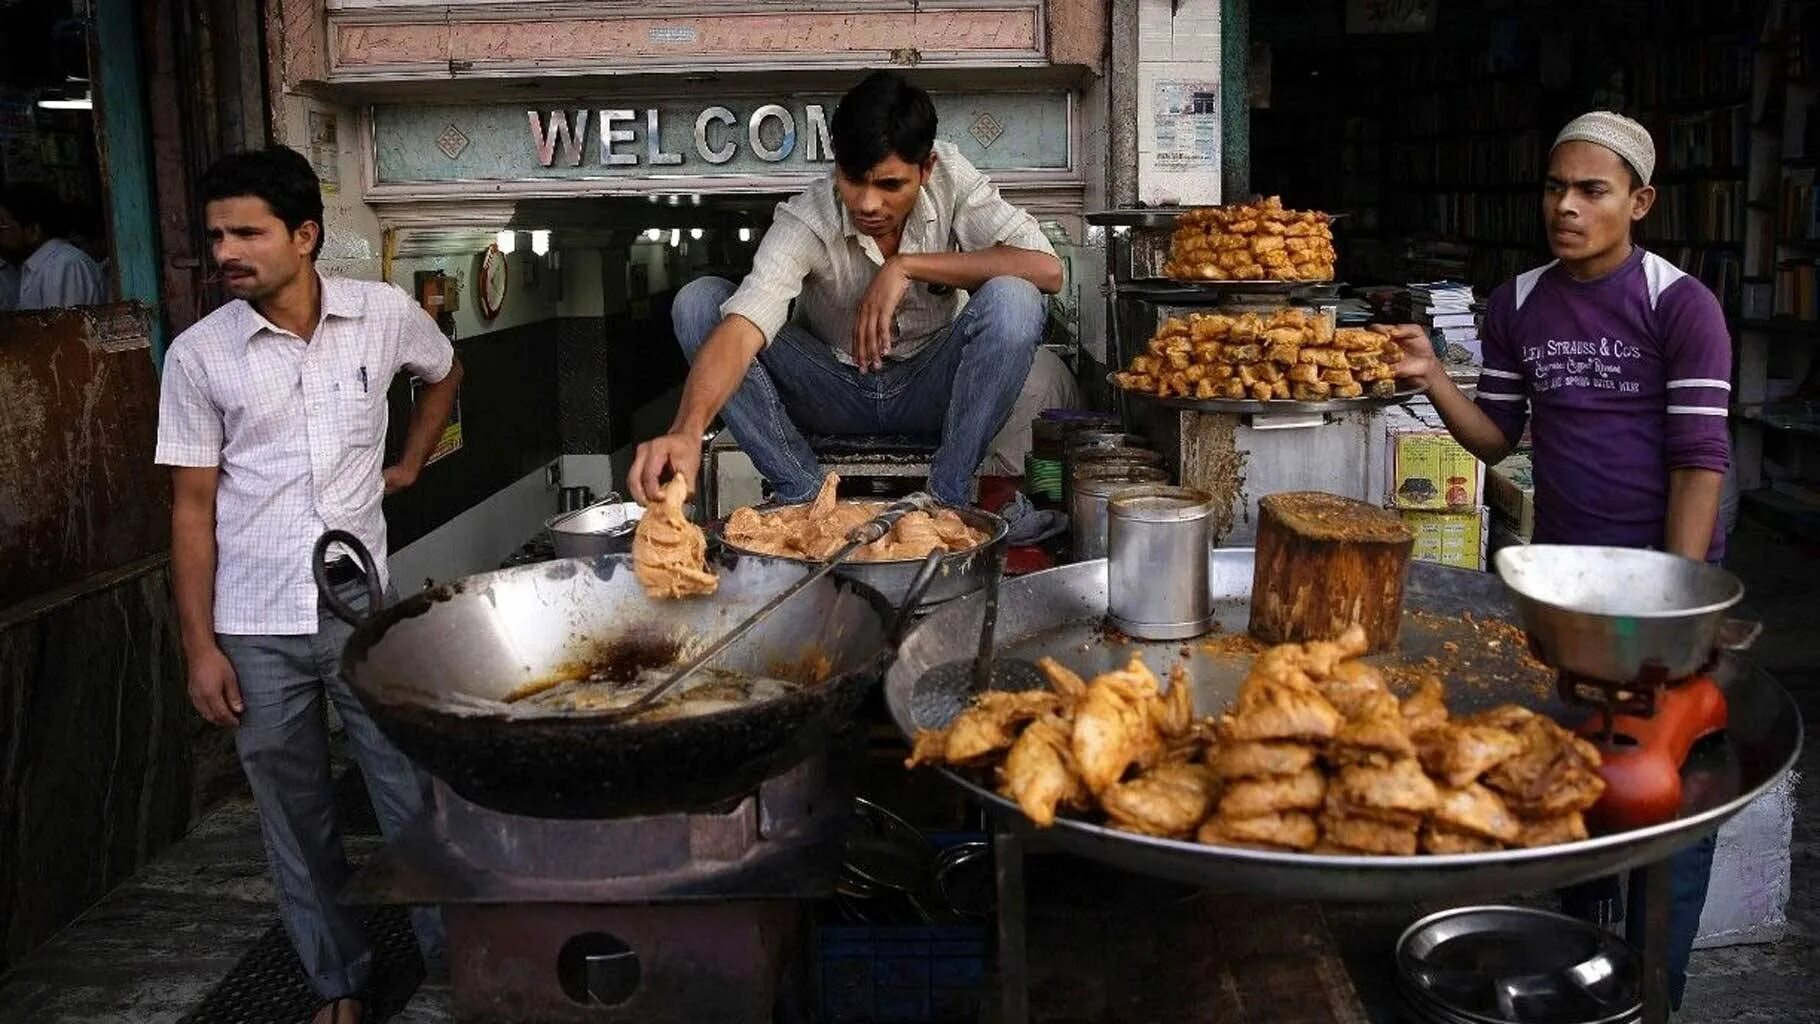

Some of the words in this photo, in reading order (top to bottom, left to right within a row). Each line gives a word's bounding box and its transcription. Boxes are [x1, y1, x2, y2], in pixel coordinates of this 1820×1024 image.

[527, 104, 836, 166] WELCOM
[1547, 340, 1597, 356] STRAUSS
[1600, 337, 1611, 356] &
